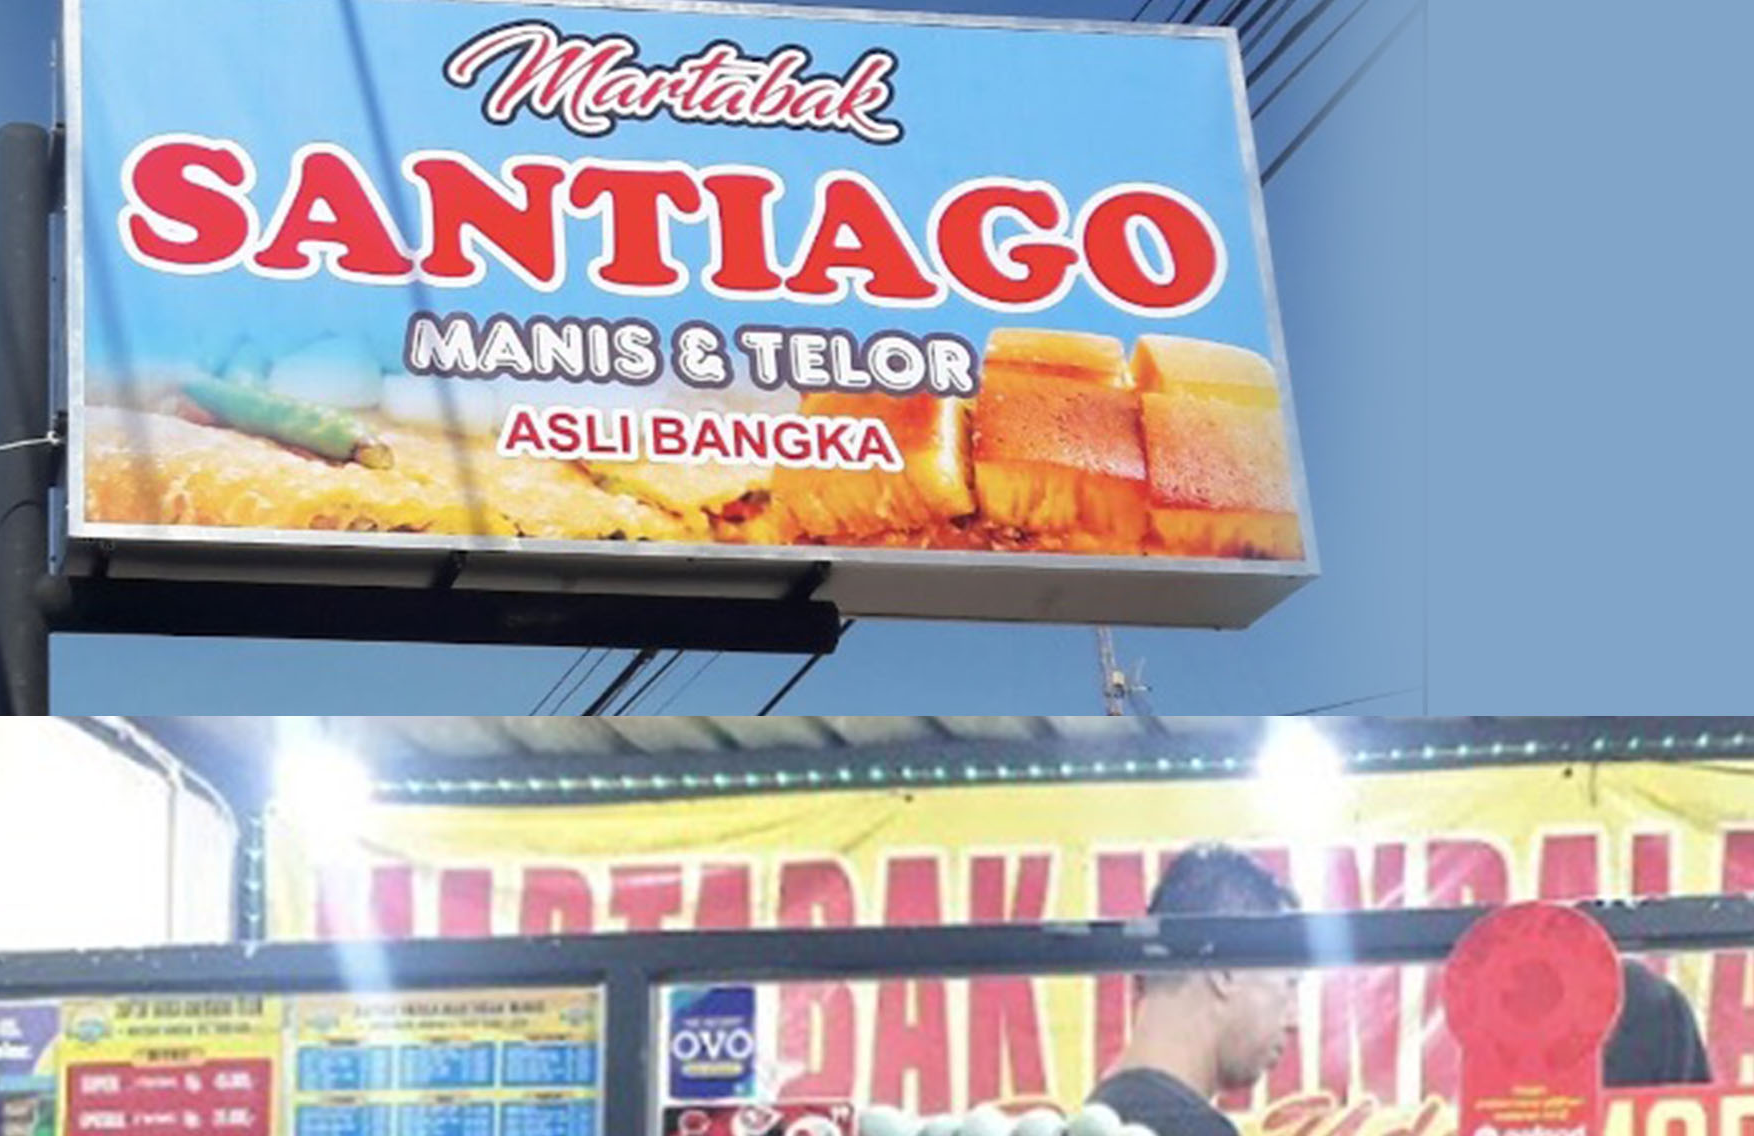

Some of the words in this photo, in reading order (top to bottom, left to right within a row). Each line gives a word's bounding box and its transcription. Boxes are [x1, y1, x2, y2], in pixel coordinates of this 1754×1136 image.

[449, 24, 901, 141] Martabak
[122, 134, 1224, 316] SANTIAGO
[410, 316, 658, 383] MANIS
[678, 323, 730, 387] &
[743, 328, 977, 394] TELOR
[505, 411, 633, 458] ASLI
[652, 418, 894, 467] BANGKA
[672, 1028, 754, 1060] OVO
